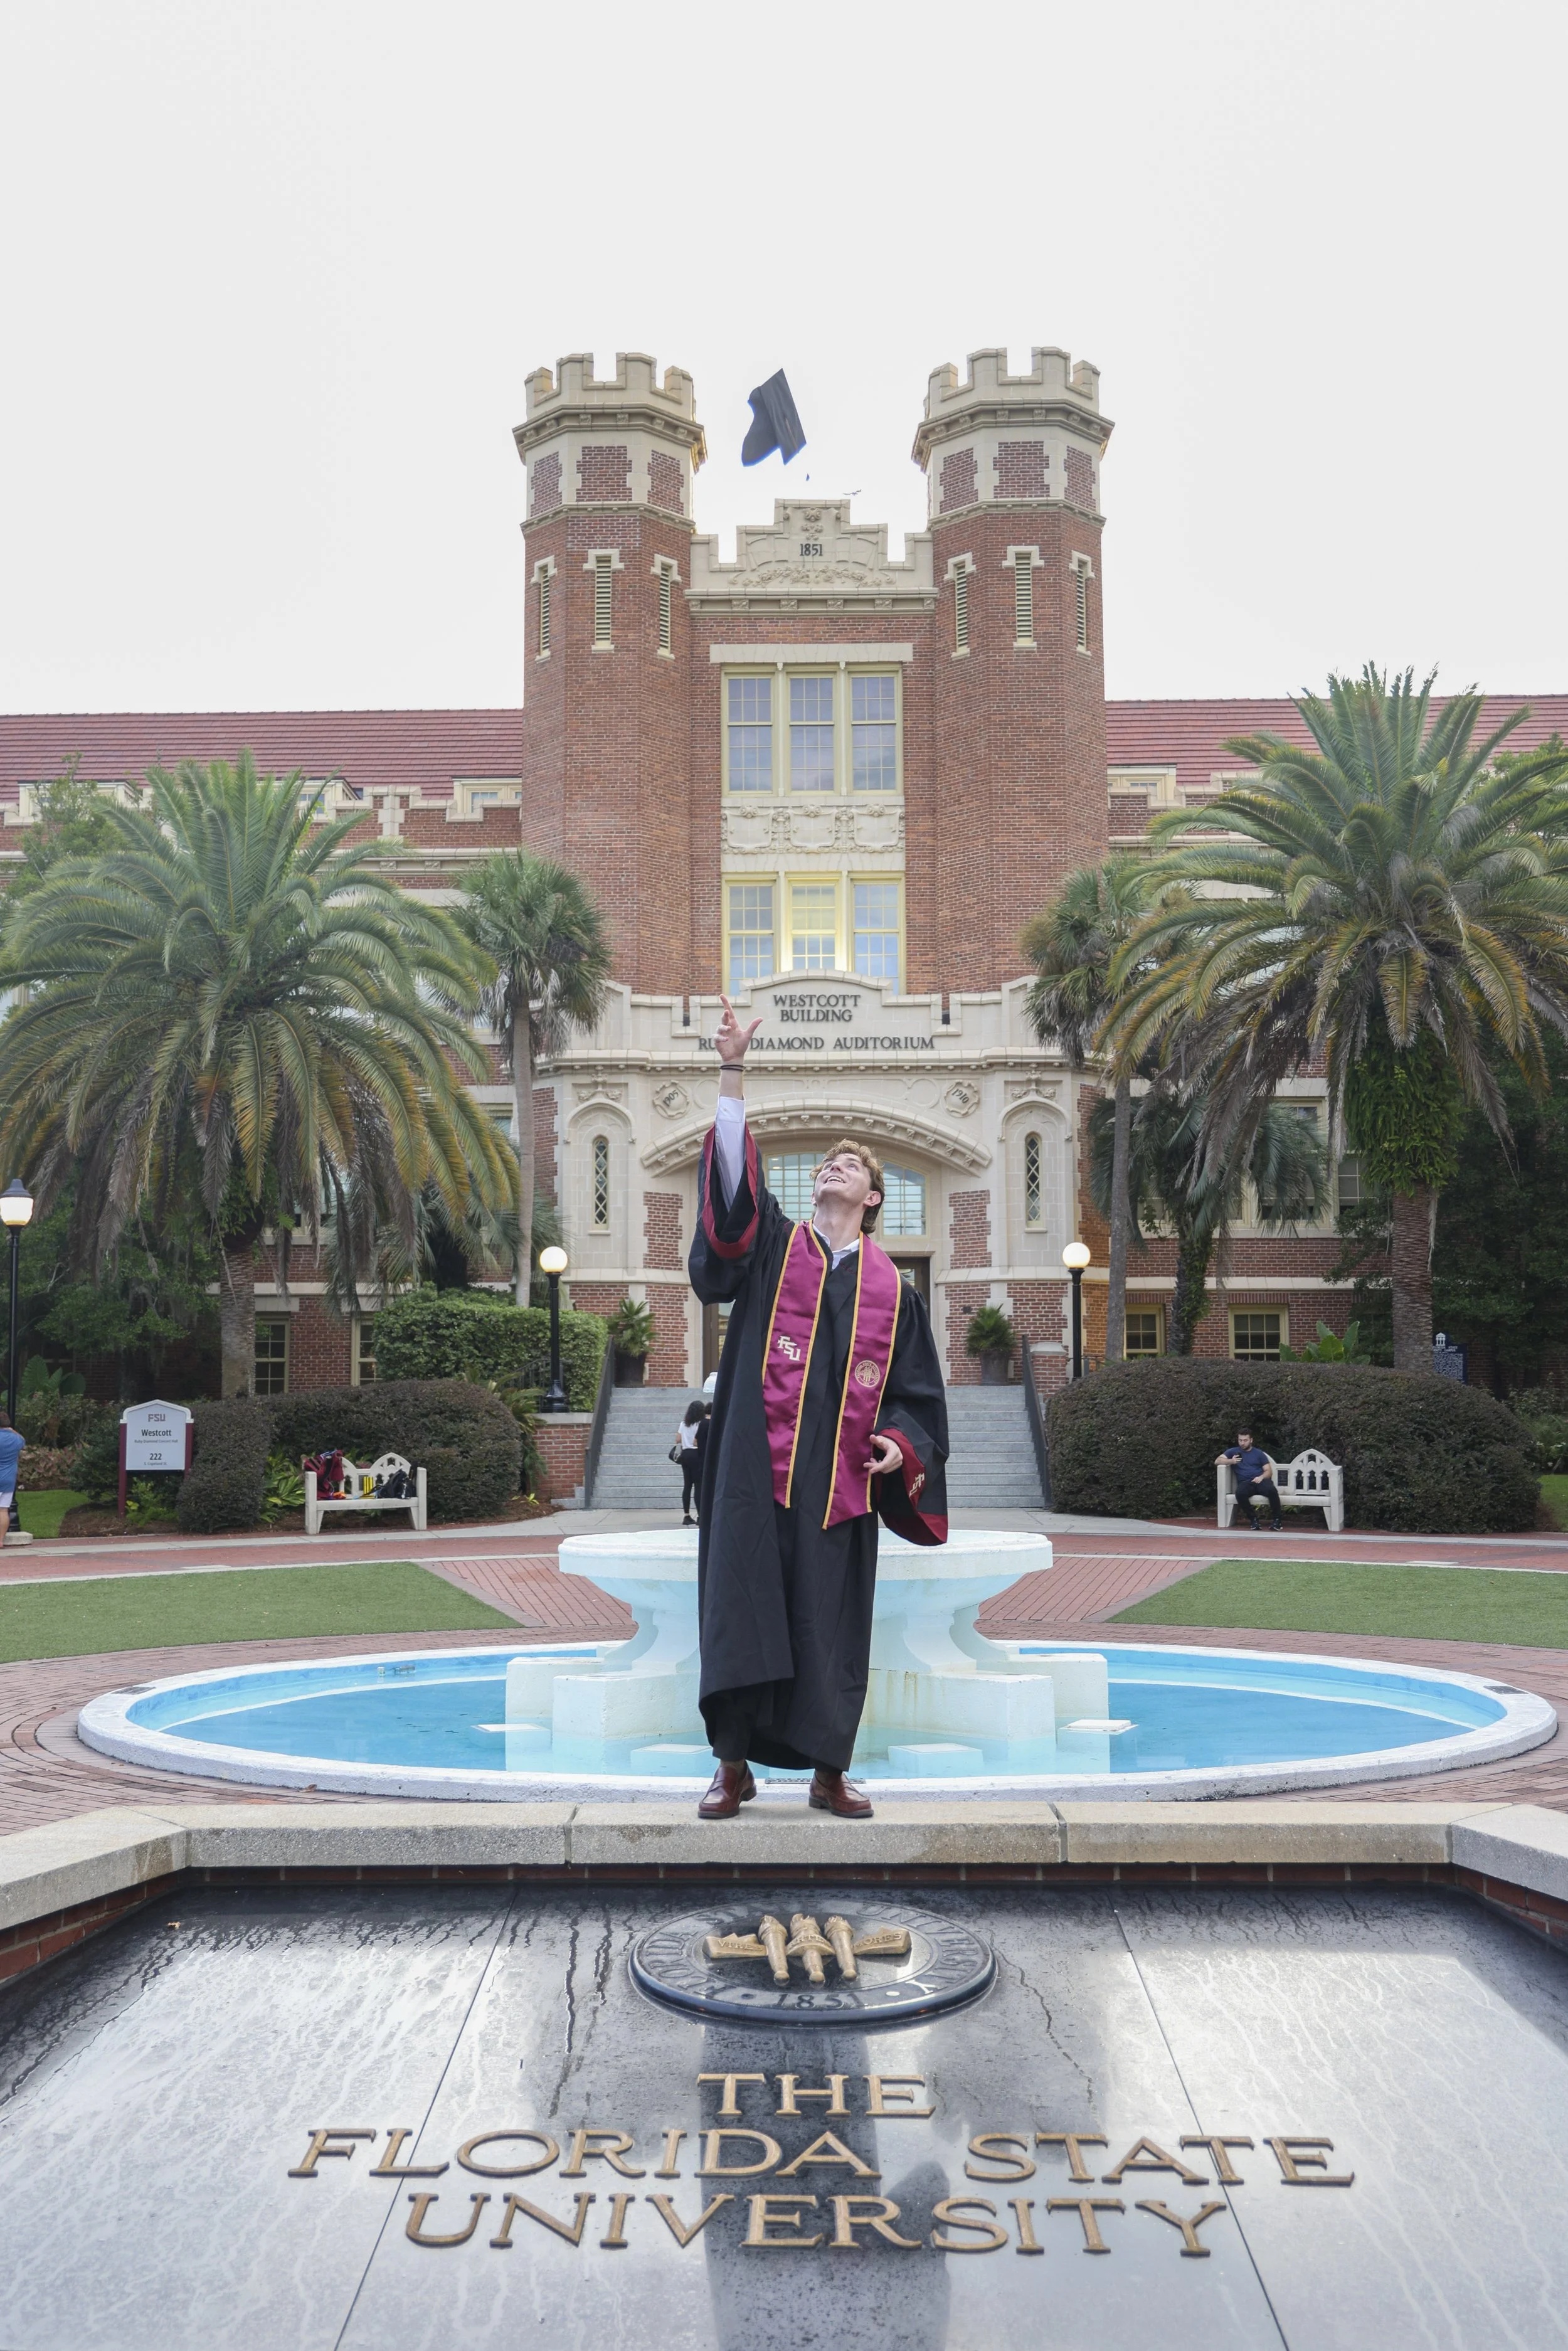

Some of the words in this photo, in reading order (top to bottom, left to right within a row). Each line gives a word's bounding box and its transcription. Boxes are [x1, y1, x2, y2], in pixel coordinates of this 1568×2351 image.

[800, 543, 823, 556] 1851
[773, 994, 861, 1007] WESTCOTT
[780, 1009, 853, 1022] BUILDING
[750, 1037, 824, 1049] DIAMOND
[833, 1036, 935, 1049] AUDITORIUM
[663, 1090, 679, 1107] 1905
[951, 1088, 969, 1104] 1910
[778, 1335, 801, 1361] FSU
[147, 1413, 166, 1422] FSU
[718, 1939, 763, 1951] VIRES
[775, 1993, 869, 2009] 1851
[697, 2072, 936, 2117] THE
[287, 2127, 882, 2179] FLORIDA
[963, 2131, 1355, 2187] STATE
[405, 2192, 1227, 2256] UNIVERSITY
